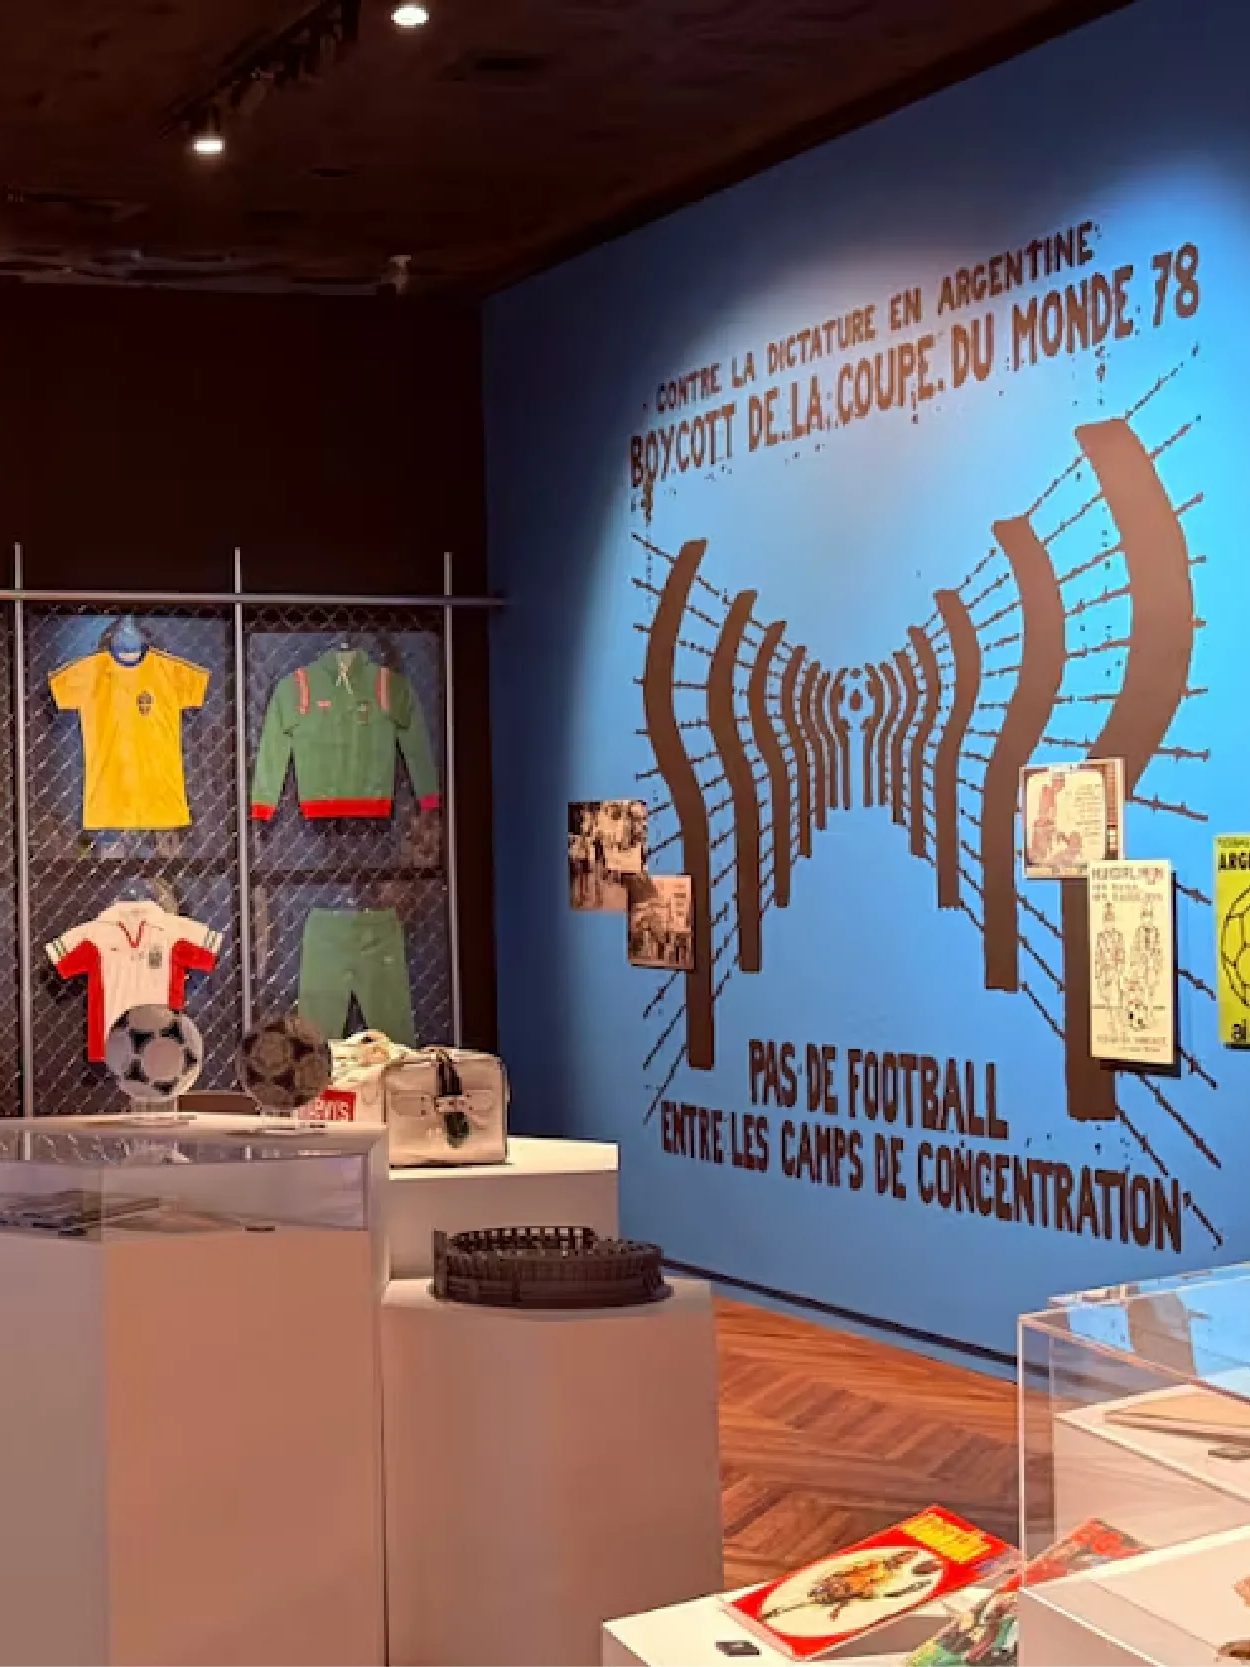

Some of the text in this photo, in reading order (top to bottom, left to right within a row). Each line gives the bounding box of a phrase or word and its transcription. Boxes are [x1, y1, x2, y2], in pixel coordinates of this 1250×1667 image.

[630, 241, 1200, 488] BOYCOTT DE LA COUPE DU MONDE 78
[655, 219, 1095, 414] CONTRE LA DICTATURE EN ARGENTINE
[1218, 852, 1250, 871] ARG
[749, 1038, 1009, 1141] PAS DE FOOTBALL
[661, 1101, 1182, 1255] ENTRE LES CAMPS DE CONCENTRATION
